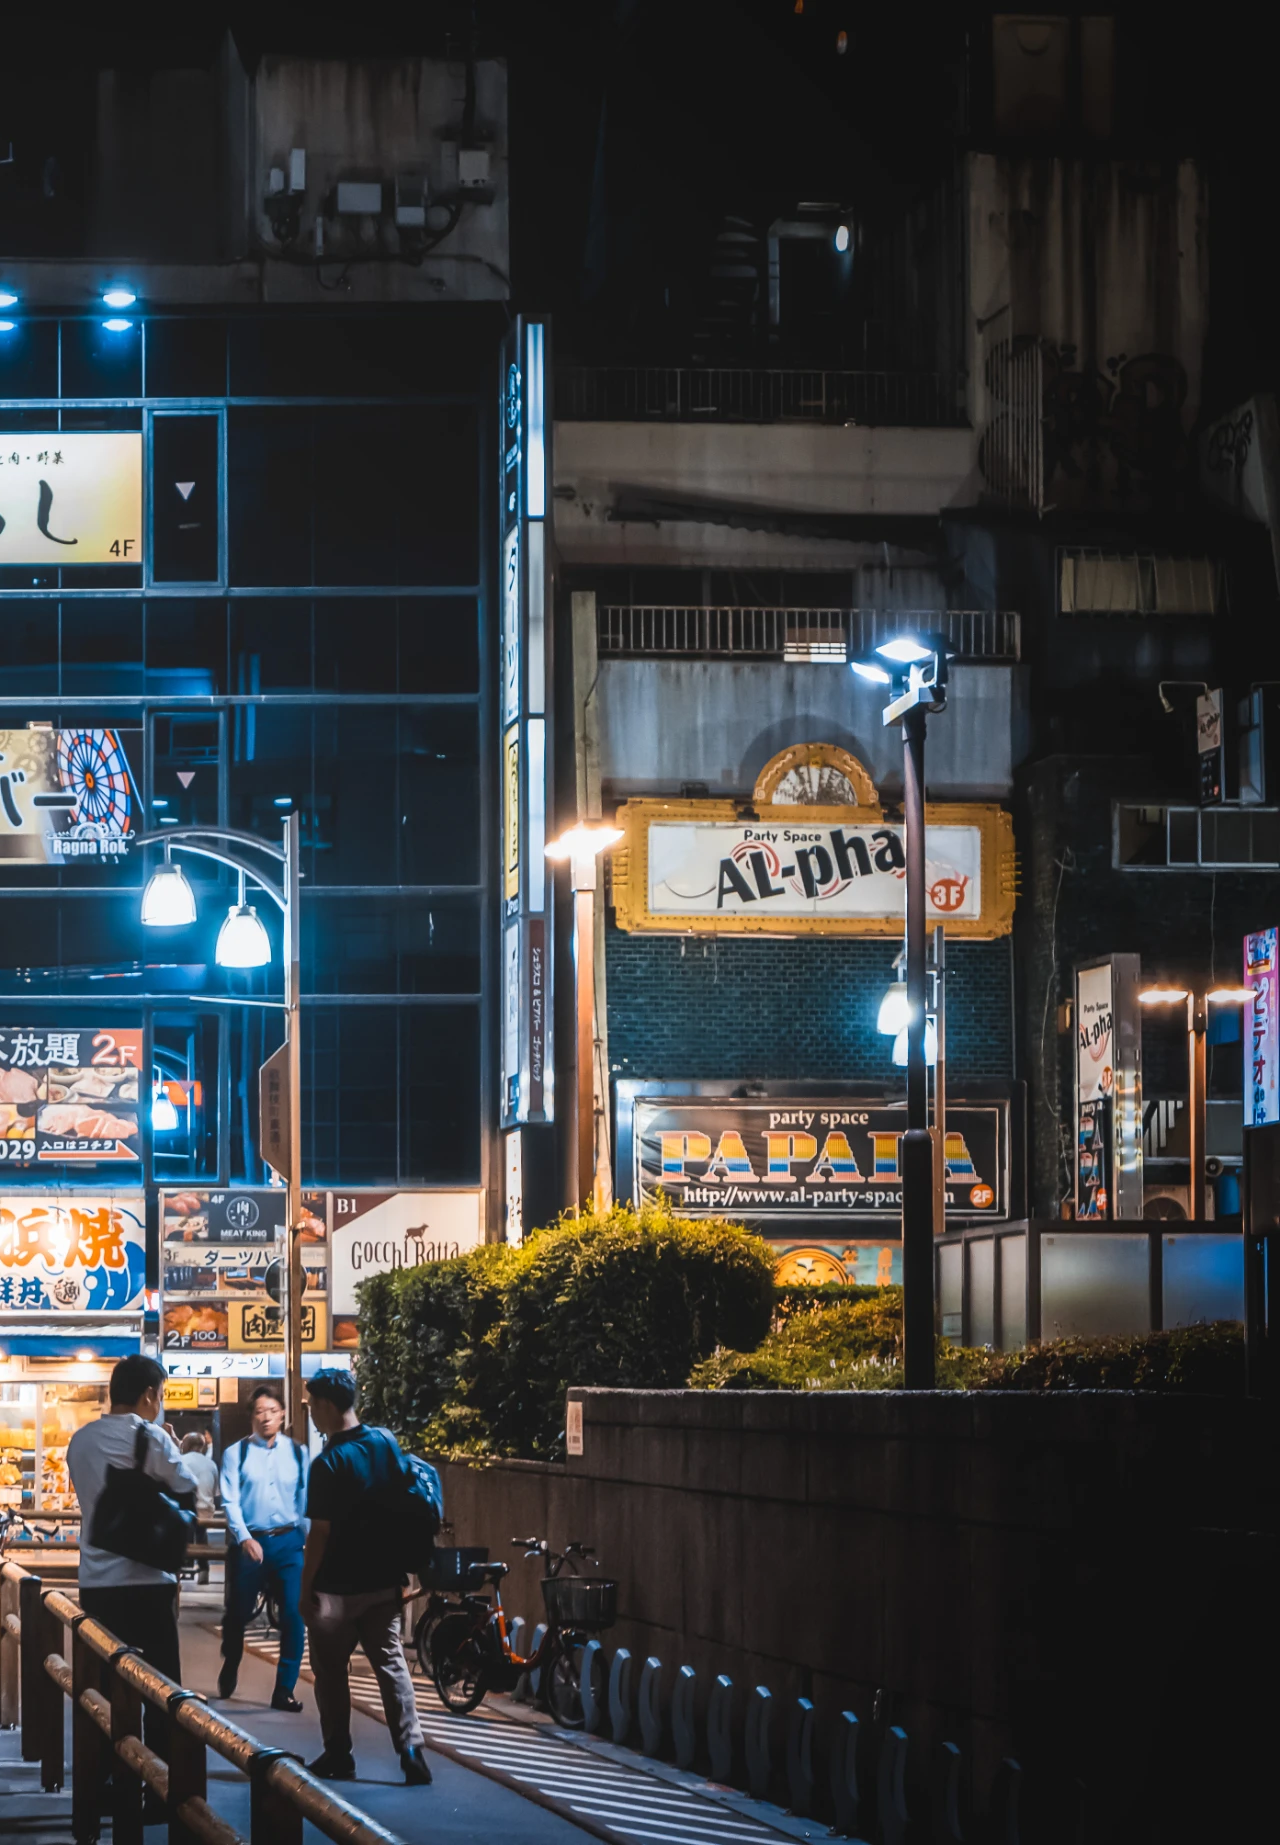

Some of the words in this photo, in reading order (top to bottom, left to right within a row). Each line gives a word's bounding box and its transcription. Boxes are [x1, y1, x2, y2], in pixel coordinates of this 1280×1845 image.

[108, 539, 136, 557] 4F
[743, 829, 778, 843] Party
[783, 829, 822, 843] Space
[53, 839, 97, 856] Ragna
[933, 884, 960, 906] 3F
[91, 1033, 137, 1066] 2F
[769, 1110, 815, 1129] party
[820, 1112, 869, 1129] space
[41, 1140, 113, 1150] 入口はコチラ
[211, 1194, 225, 1204] 4F
[973, 1190, 991, 1203] 2F
[166, 1330, 190, 1347] 2F
